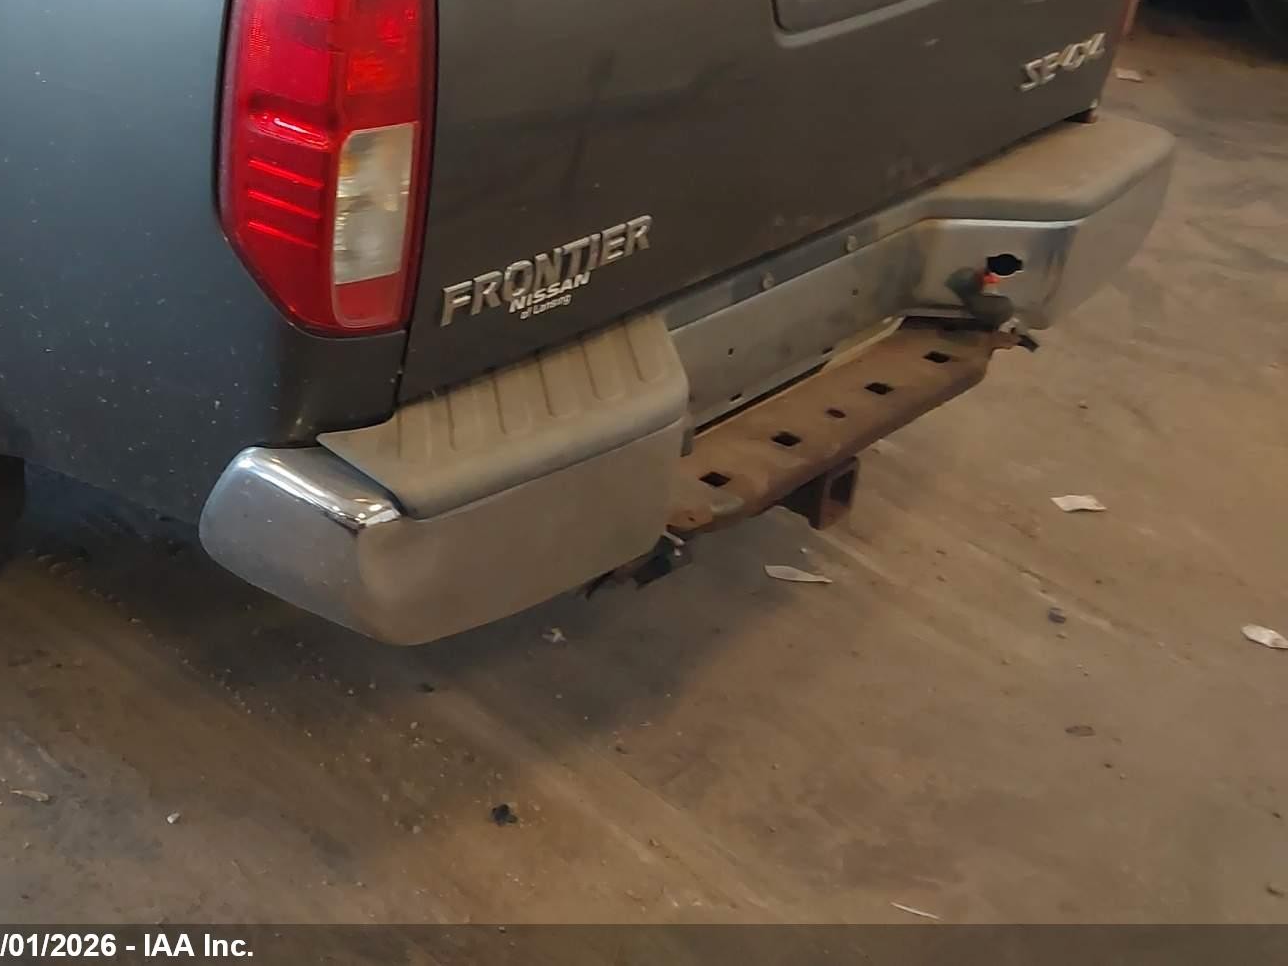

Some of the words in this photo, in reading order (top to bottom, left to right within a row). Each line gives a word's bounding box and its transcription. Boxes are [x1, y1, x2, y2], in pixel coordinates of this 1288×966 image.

[440, 214, 653, 327] FRONTIER
[509, 270, 591, 313] NISSAN
[533, 294, 572, 315] Lansing
